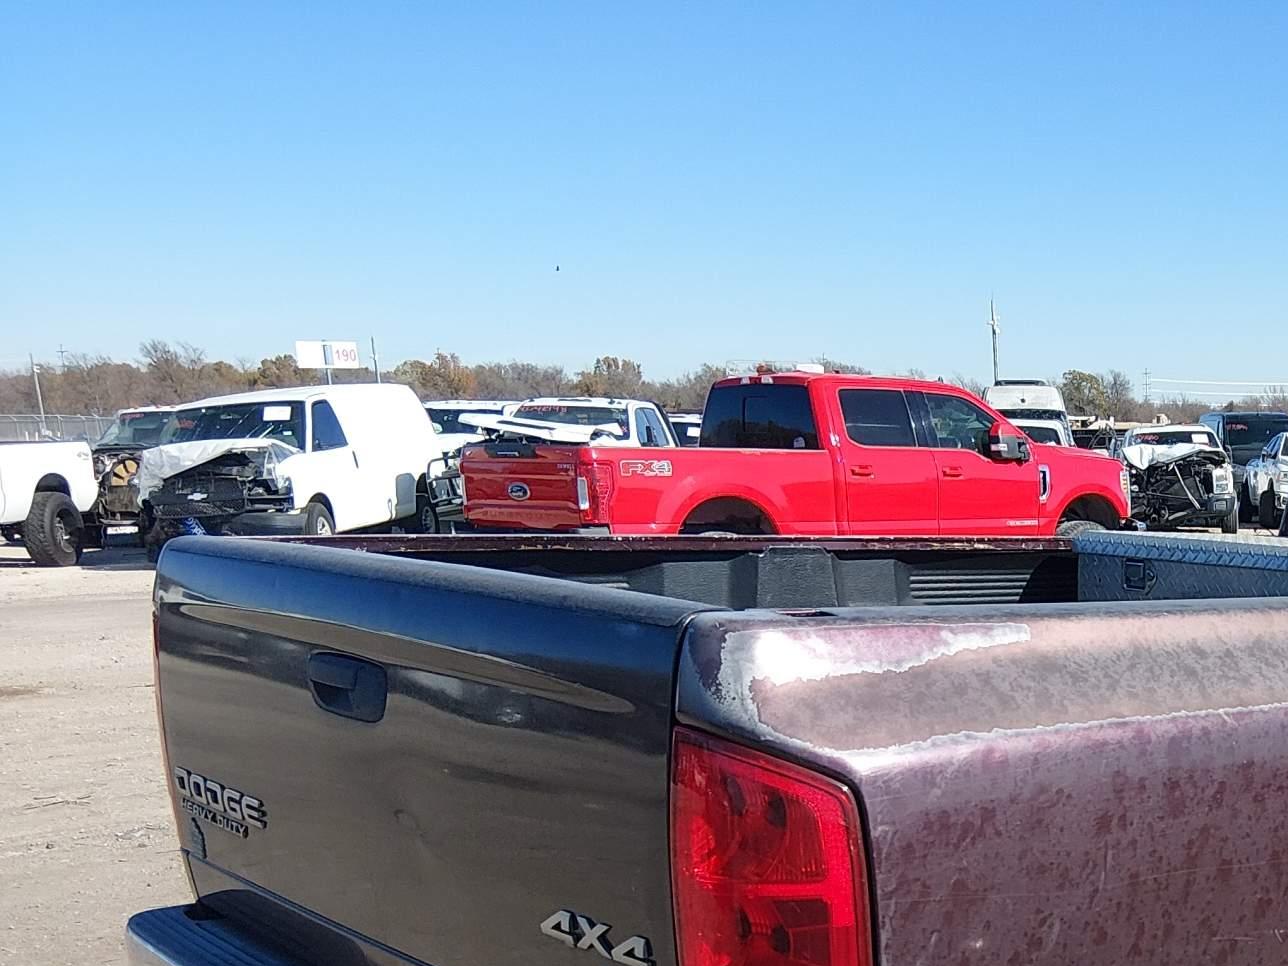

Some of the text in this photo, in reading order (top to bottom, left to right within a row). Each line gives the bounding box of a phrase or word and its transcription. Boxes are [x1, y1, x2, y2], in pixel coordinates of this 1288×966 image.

[335, 348, 357, 362] 190
[619, 459, 673, 477] FX4
[174, 766, 268, 829] DODGE
[182, 798, 248, 838] HEAVY DUTY
